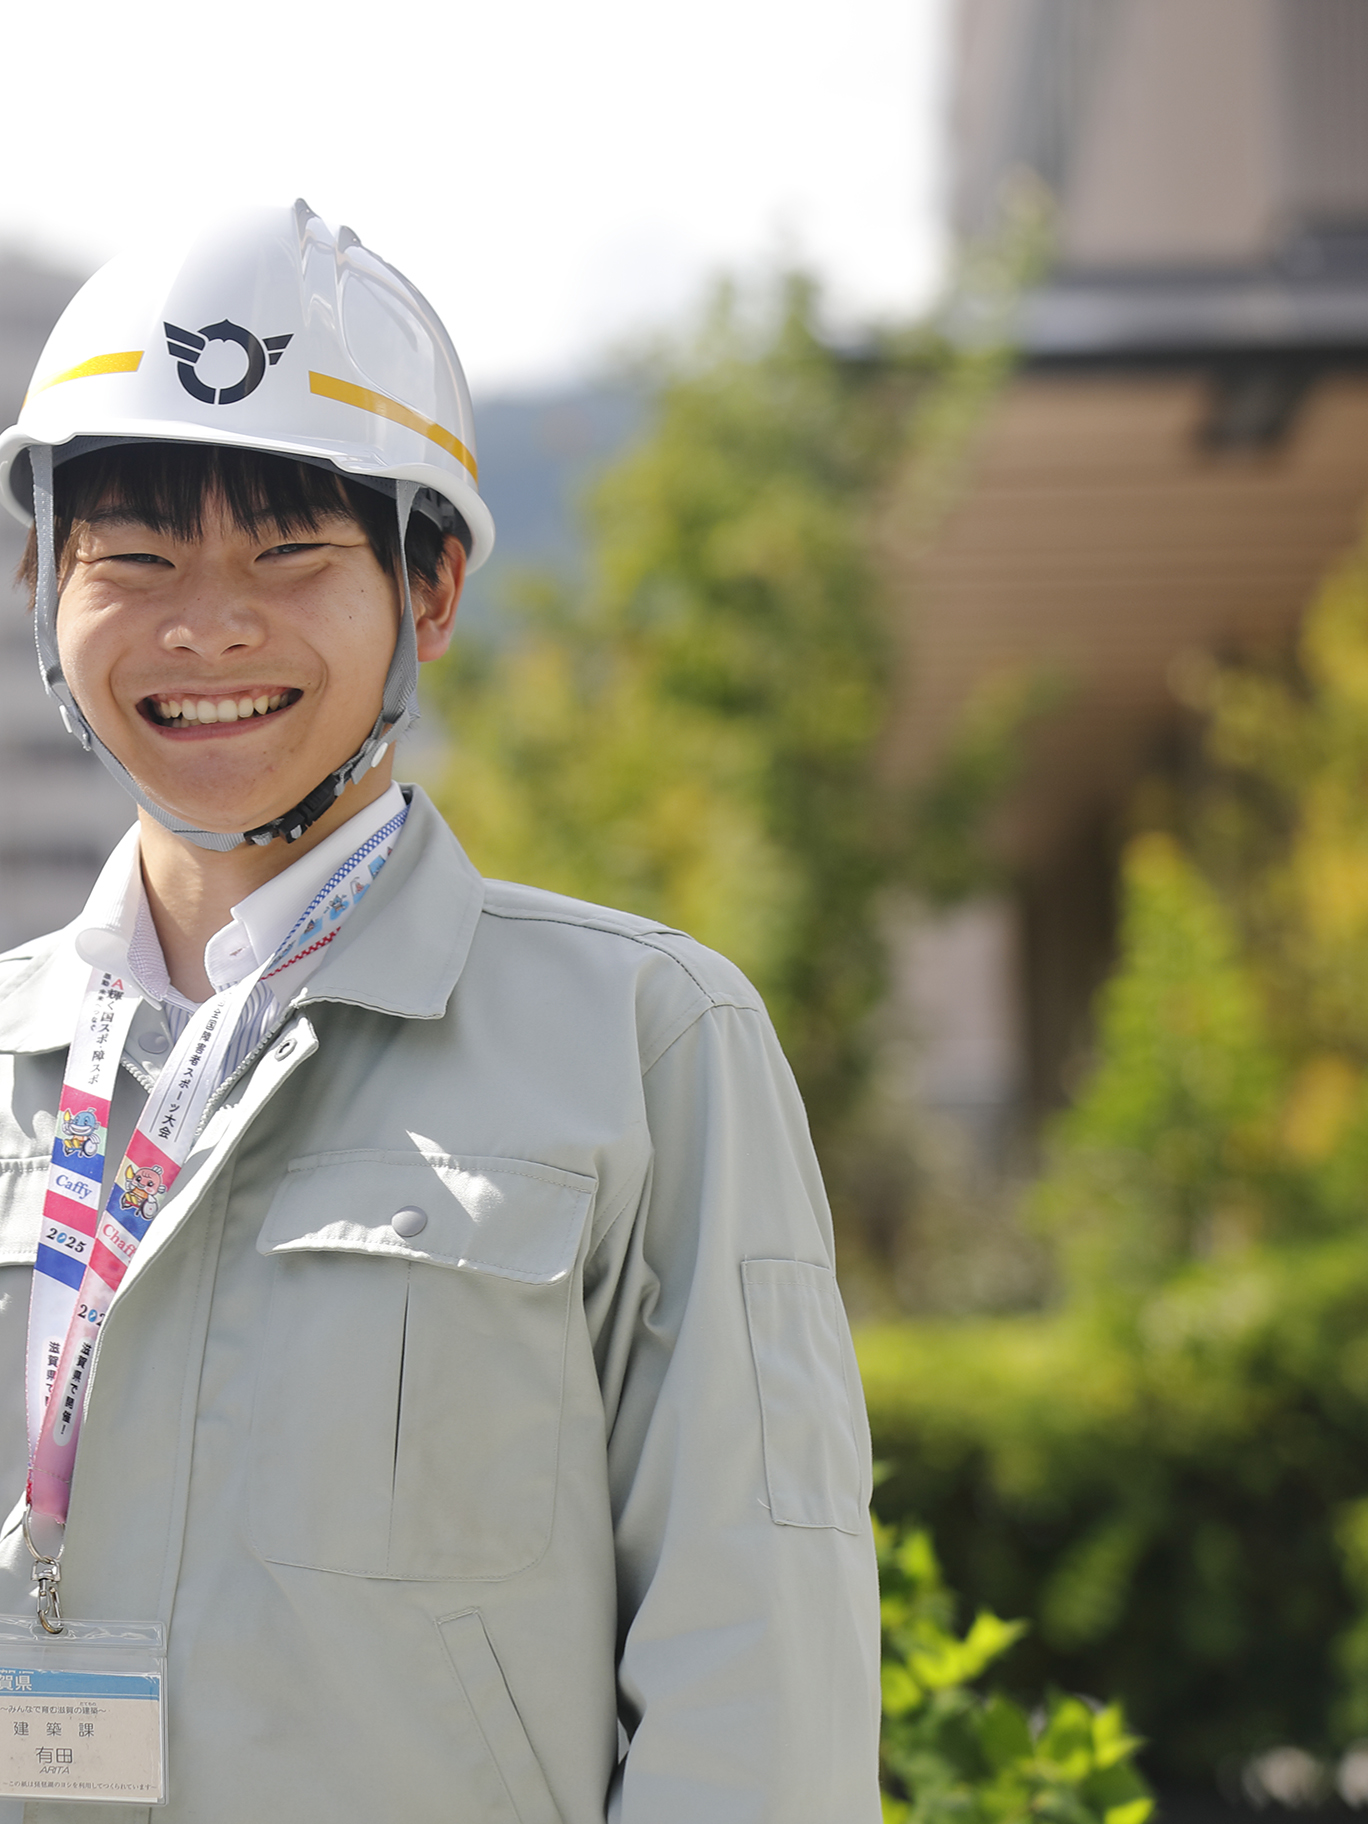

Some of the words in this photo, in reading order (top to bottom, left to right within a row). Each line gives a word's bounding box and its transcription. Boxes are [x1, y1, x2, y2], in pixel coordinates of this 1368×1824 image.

[55, 1174, 93, 1200] Caffy
[45, 1227, 88, 1254] 2025
[44, 1341, 61, 1407] 滋賀県で
[35, 1746, 73, 1764] 有田
[39, 1765, 70, 1775] ARITA
